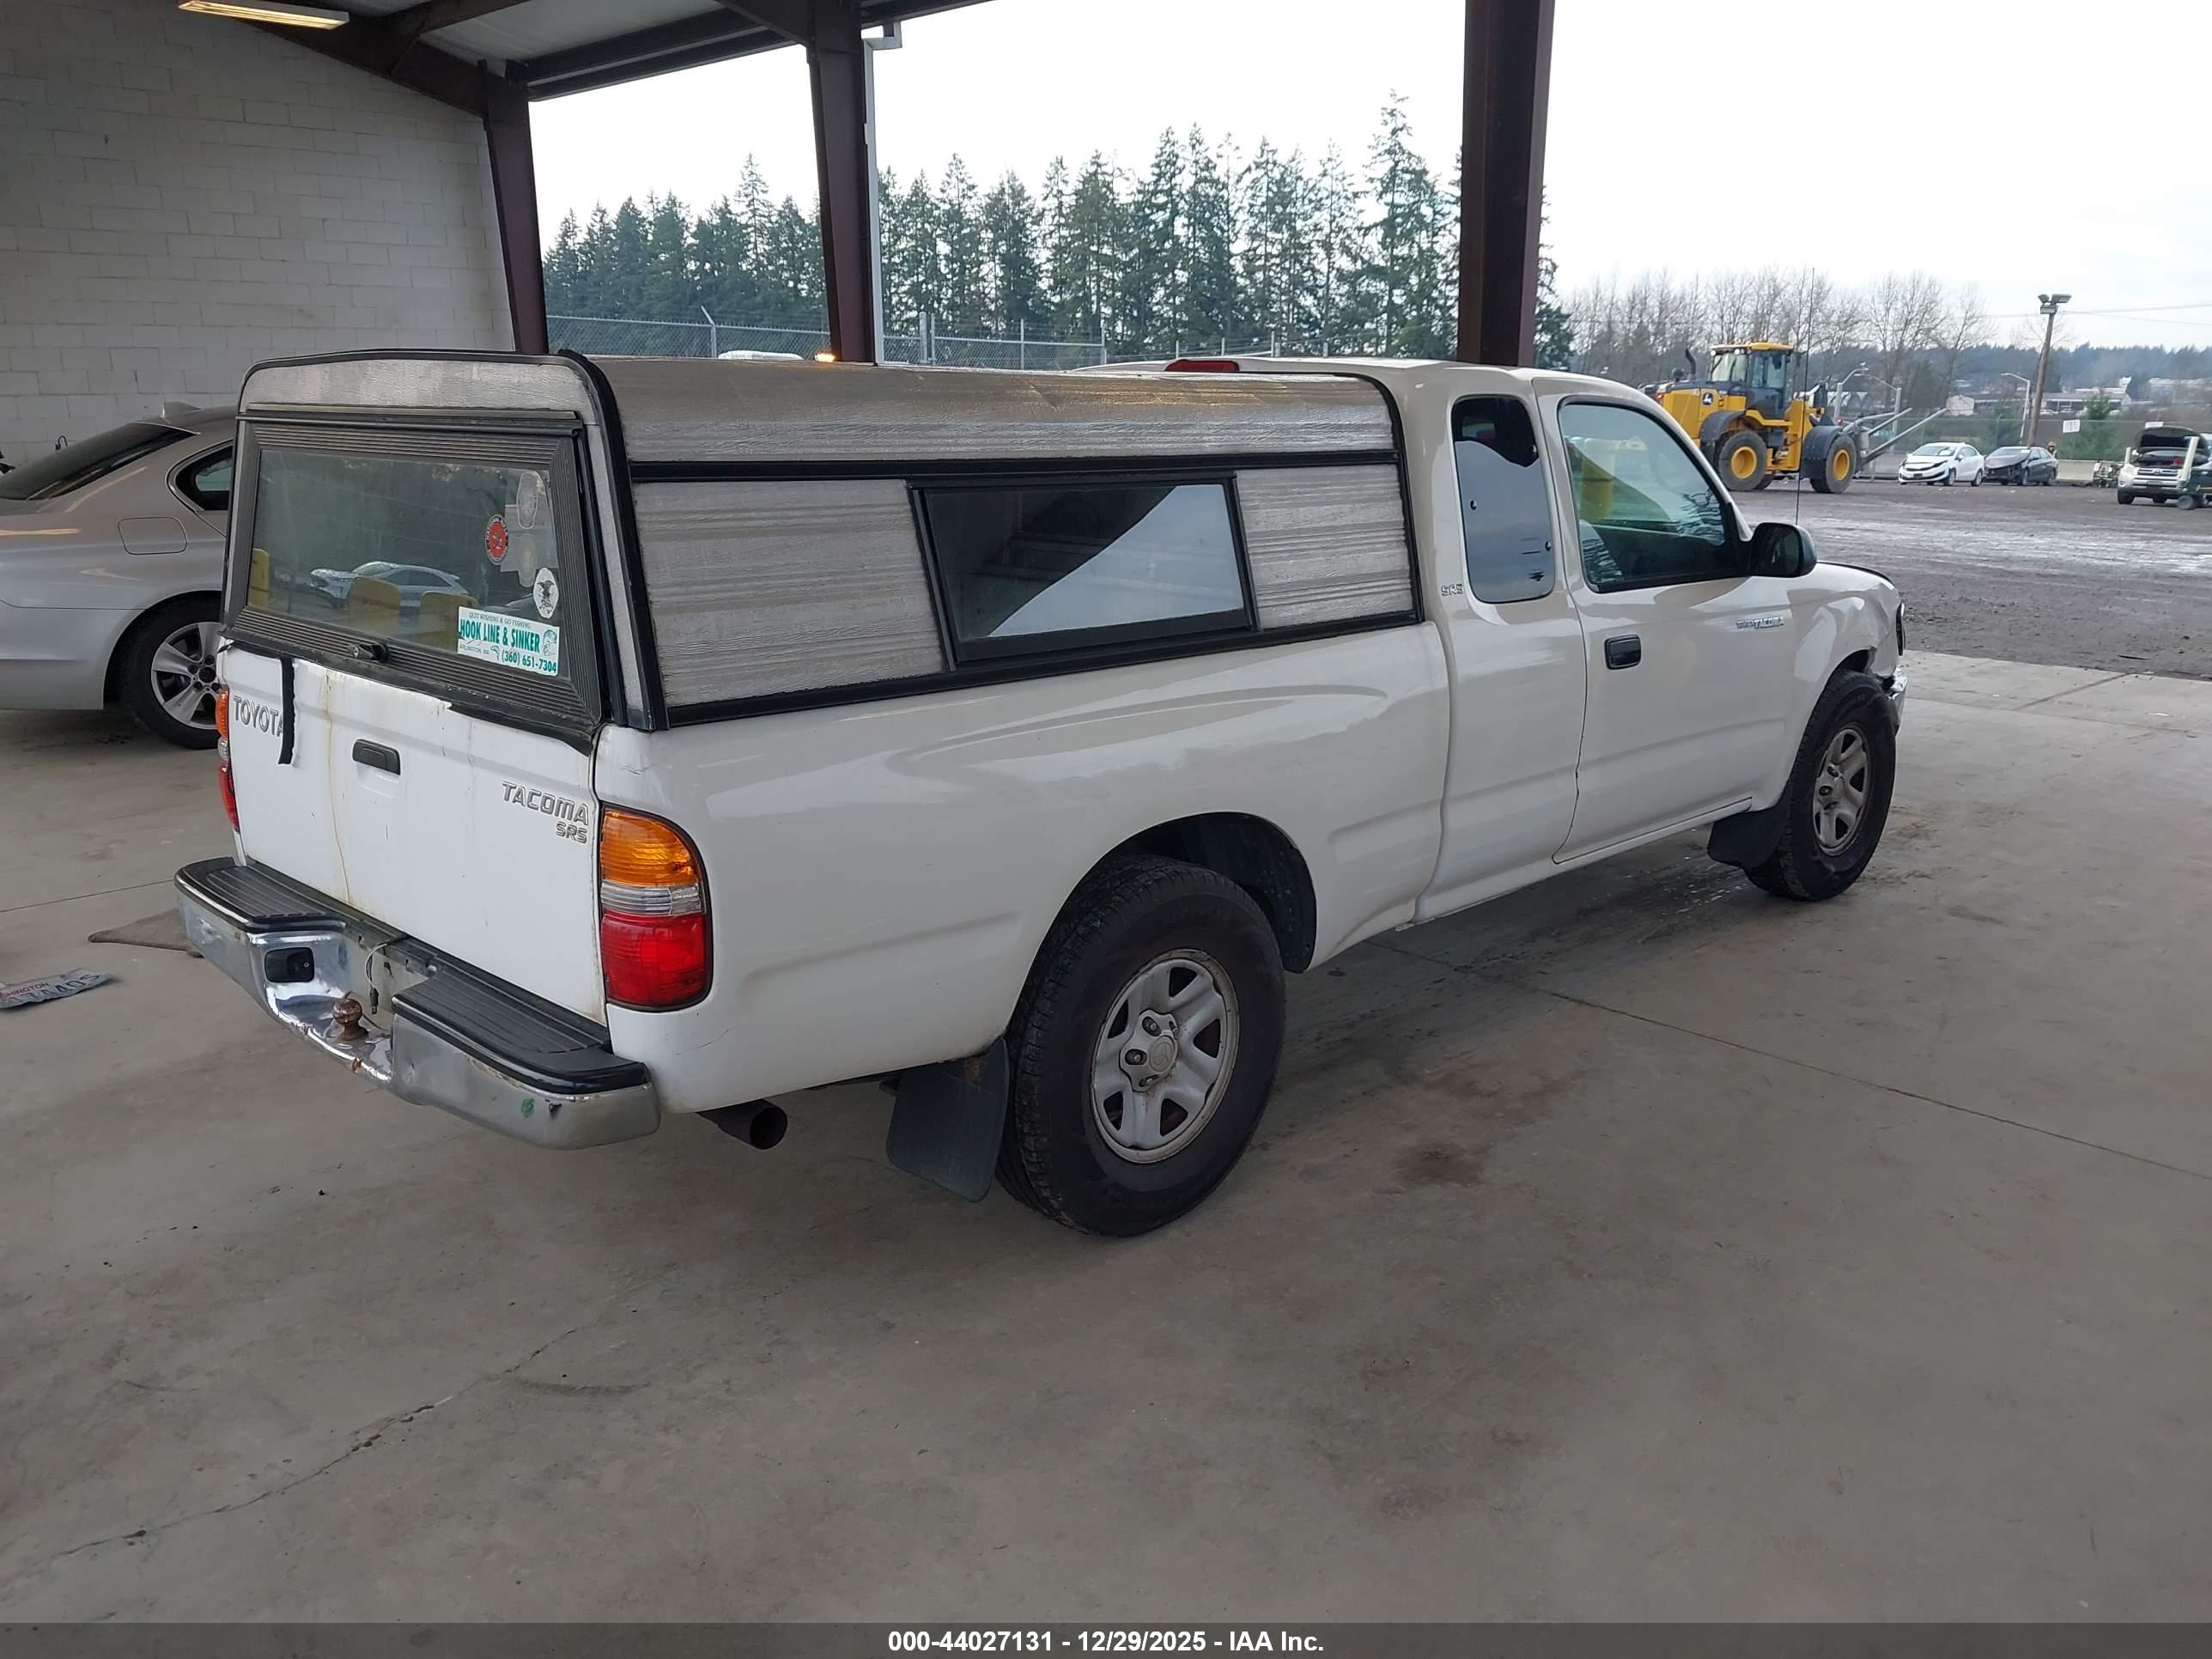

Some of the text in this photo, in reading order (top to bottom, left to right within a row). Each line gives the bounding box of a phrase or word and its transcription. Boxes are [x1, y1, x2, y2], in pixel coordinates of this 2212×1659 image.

[459, 618, 540, 653] HOOK LINE & SINKER
[512, 620, 531, 629] FISHING
[501, 649, 556, 673] (360) 651-7304
[502, 781, 589, 825] TACOMA
